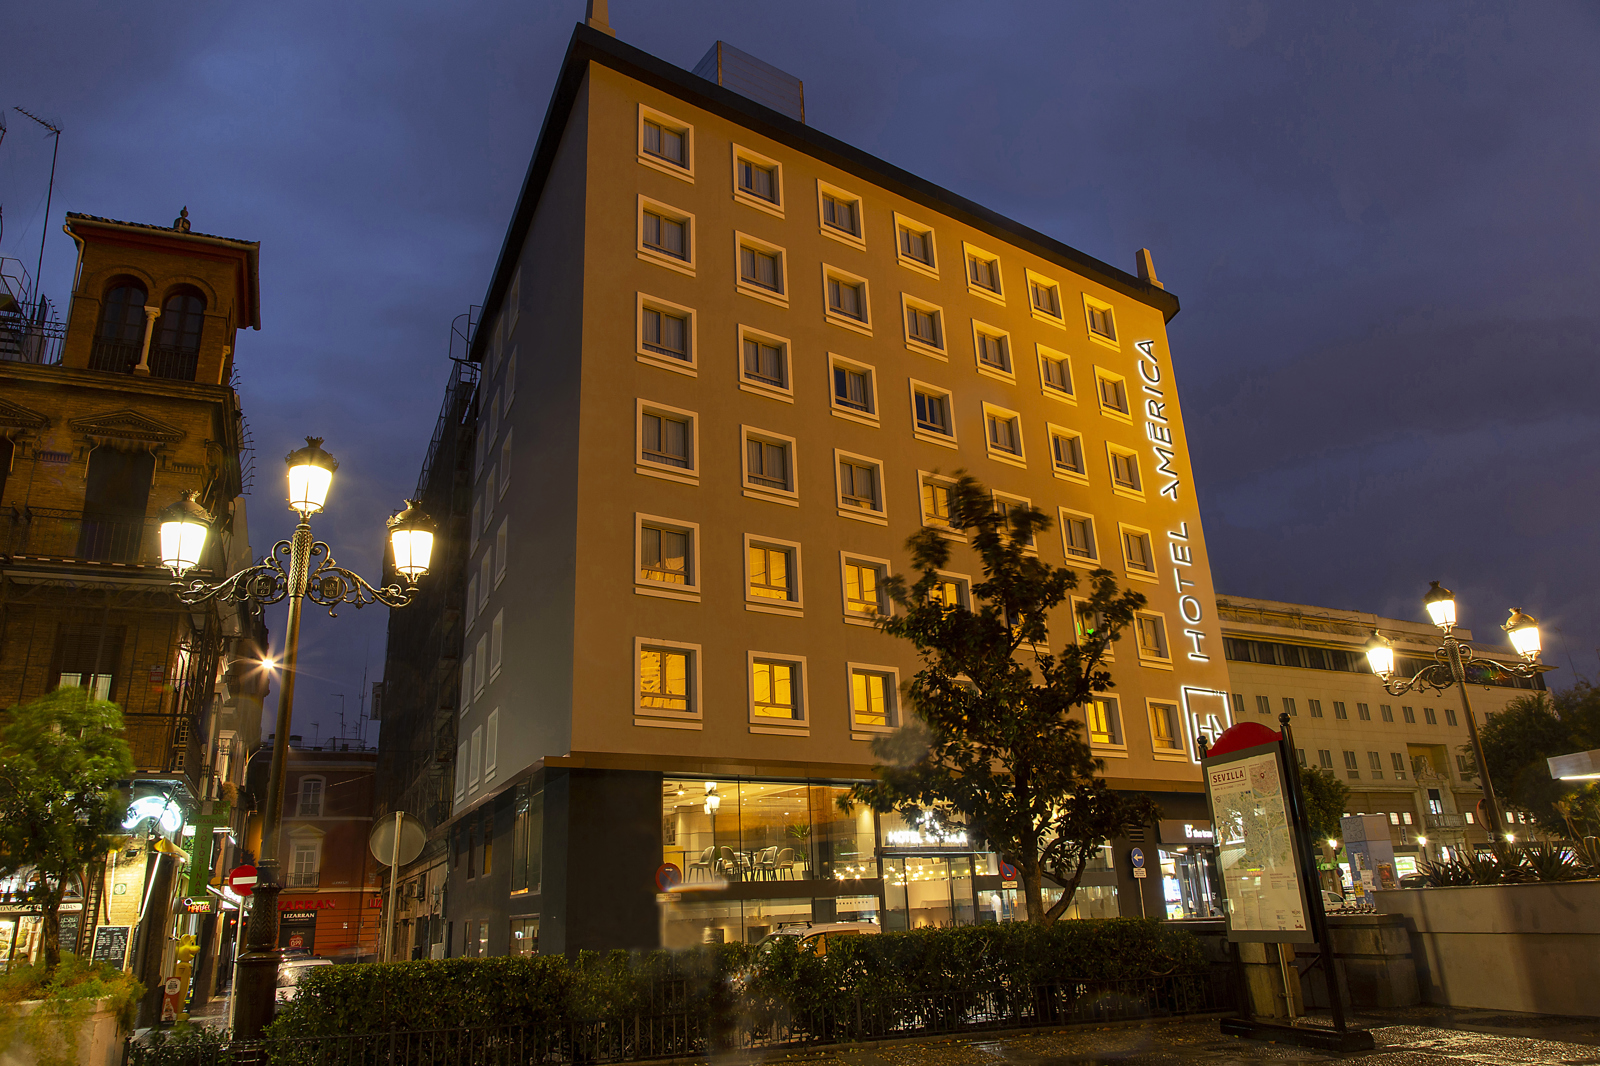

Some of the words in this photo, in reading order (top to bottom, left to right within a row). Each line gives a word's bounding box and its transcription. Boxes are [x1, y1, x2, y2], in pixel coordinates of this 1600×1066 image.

[1167, 521, 1211, 662] HOTEL
[1212, 769, 1244, 783] SEVILLA
[194, 827, 208, 895] GOLOSINAS
[278, 899, 336, 910] ZARRAN
